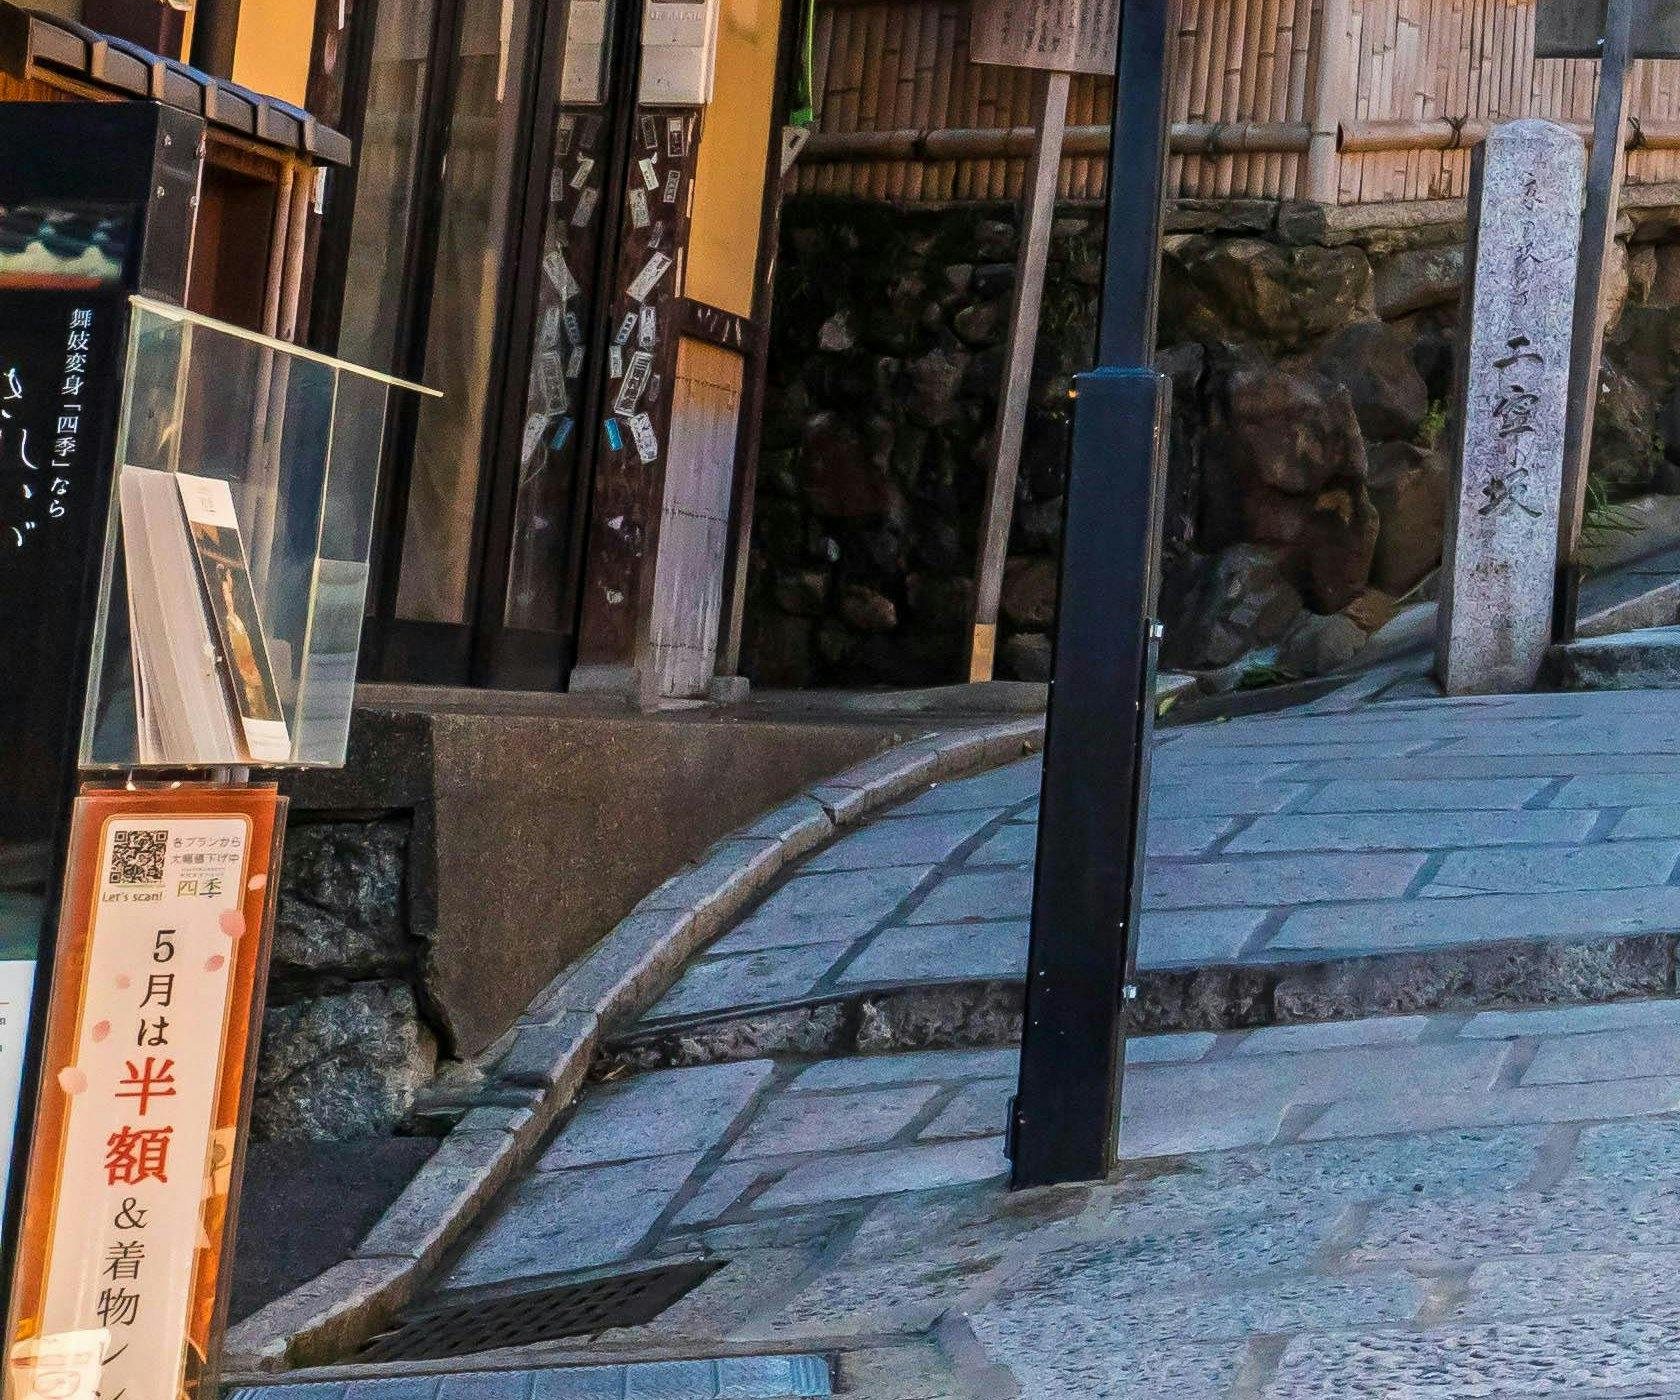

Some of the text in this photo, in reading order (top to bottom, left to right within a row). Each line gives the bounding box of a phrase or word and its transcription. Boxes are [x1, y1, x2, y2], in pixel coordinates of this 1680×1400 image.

[49, 308, 93, 518] 舞妓変身「四季」なら
[102, 891, 164, 902] Let's scan!
[93, 928, 178, 1400] 5月は半額&着物レ
